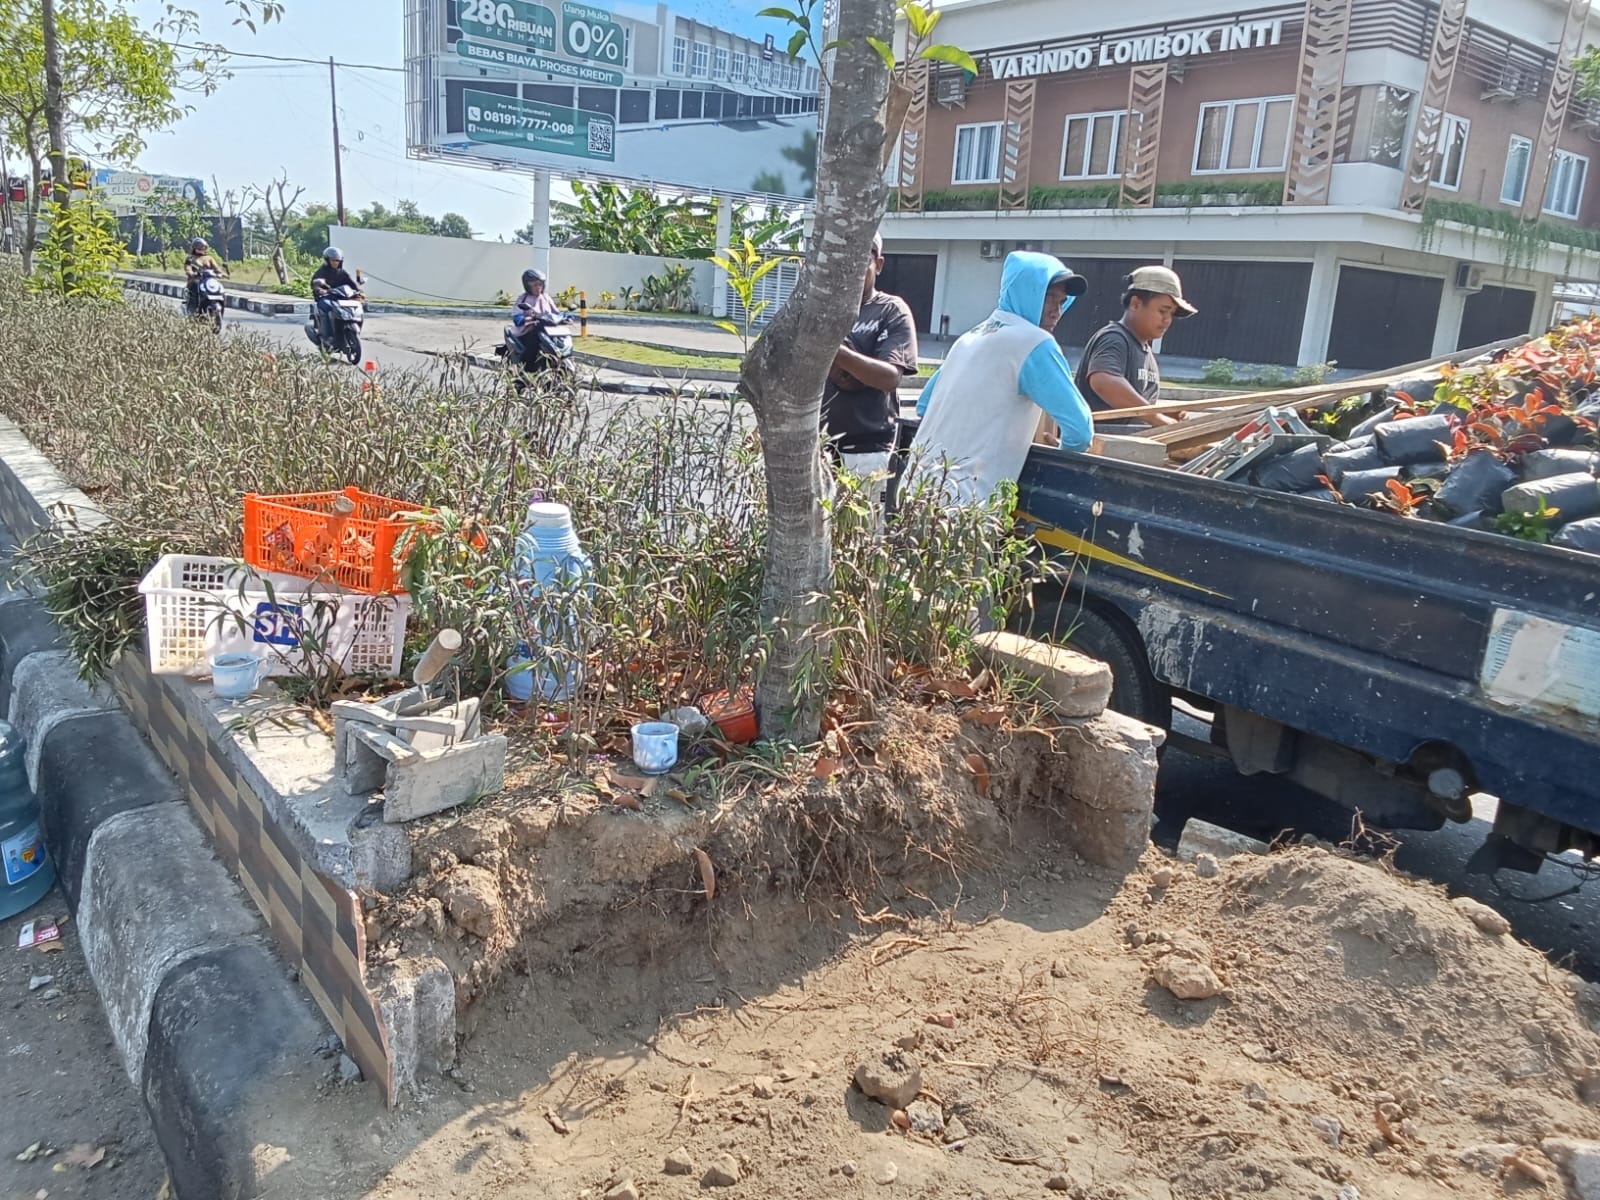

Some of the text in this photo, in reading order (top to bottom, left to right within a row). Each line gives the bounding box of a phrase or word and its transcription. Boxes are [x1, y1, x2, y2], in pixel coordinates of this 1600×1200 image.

[461, 0, 515, 29] 280
[563, 4, 609, 22] Uang Muka
[507, 18, 553, 38] RIBUAN
[568, 20, 619, 60] 0%
[467, 45, 505, 62] BEBAS
[506, 53, 539, 69] BIAYA
[540, 60, 579, 76] PROSES
[579, 68, 615, 83] KREDIT
[990, 21, 1283, 80] VARINDO LOMBOK INTI
[483, 110, 575, 135] 08191-7777-008
